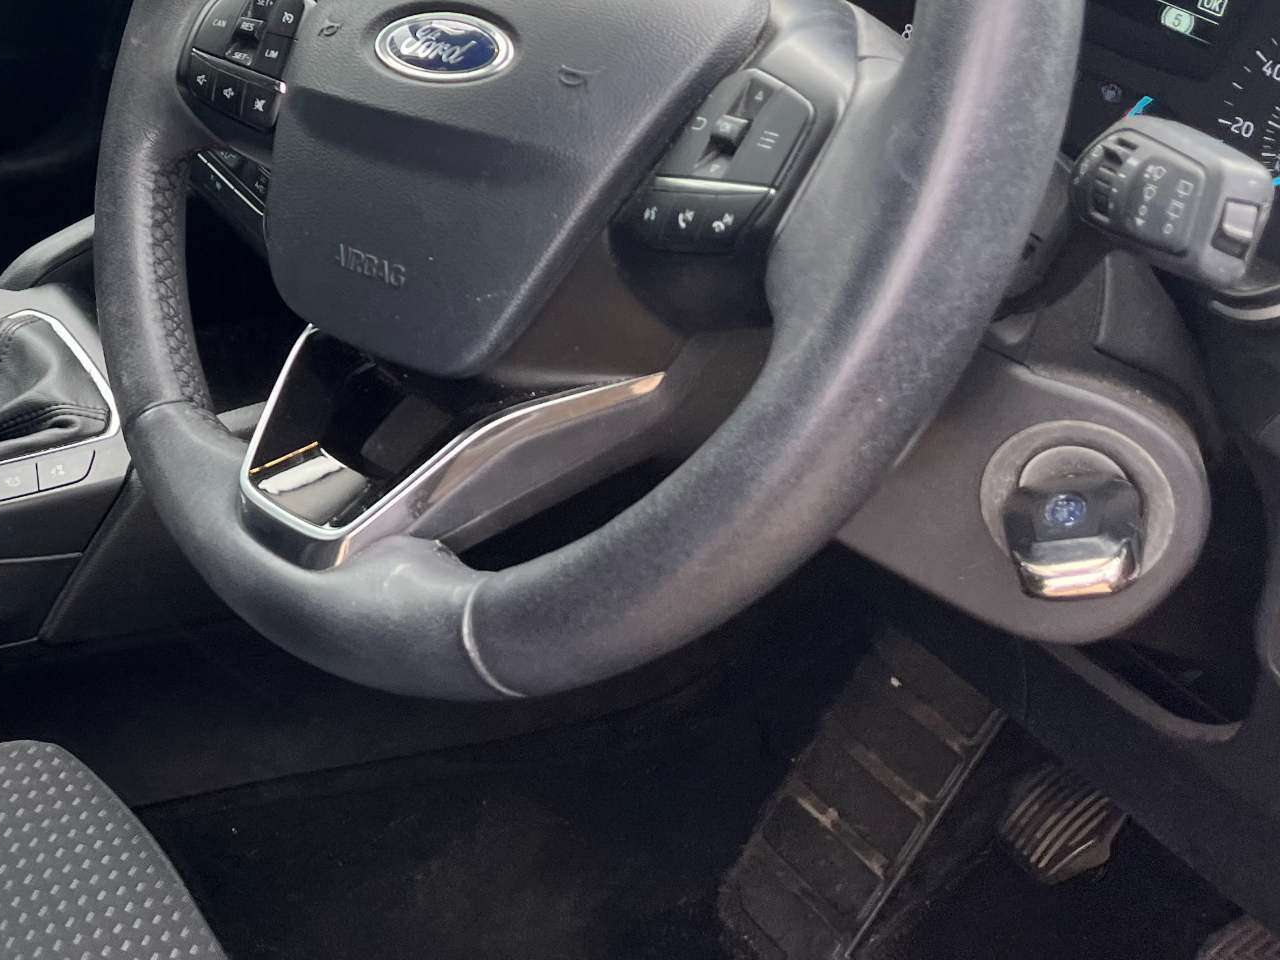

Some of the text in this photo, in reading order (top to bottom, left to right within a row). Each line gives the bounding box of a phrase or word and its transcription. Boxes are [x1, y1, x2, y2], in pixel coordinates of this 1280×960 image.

[240, 21, 256, 32] RES
[1172, 13, 1182, 28] 5
[902, 23, 913, 40] 8
[399, 22, 478, 65] Ford
[264, 49, 279, 59] LIM
[1231, 116, 1254, 138] 20
[334, 243, 406, 287] AIRBAG
